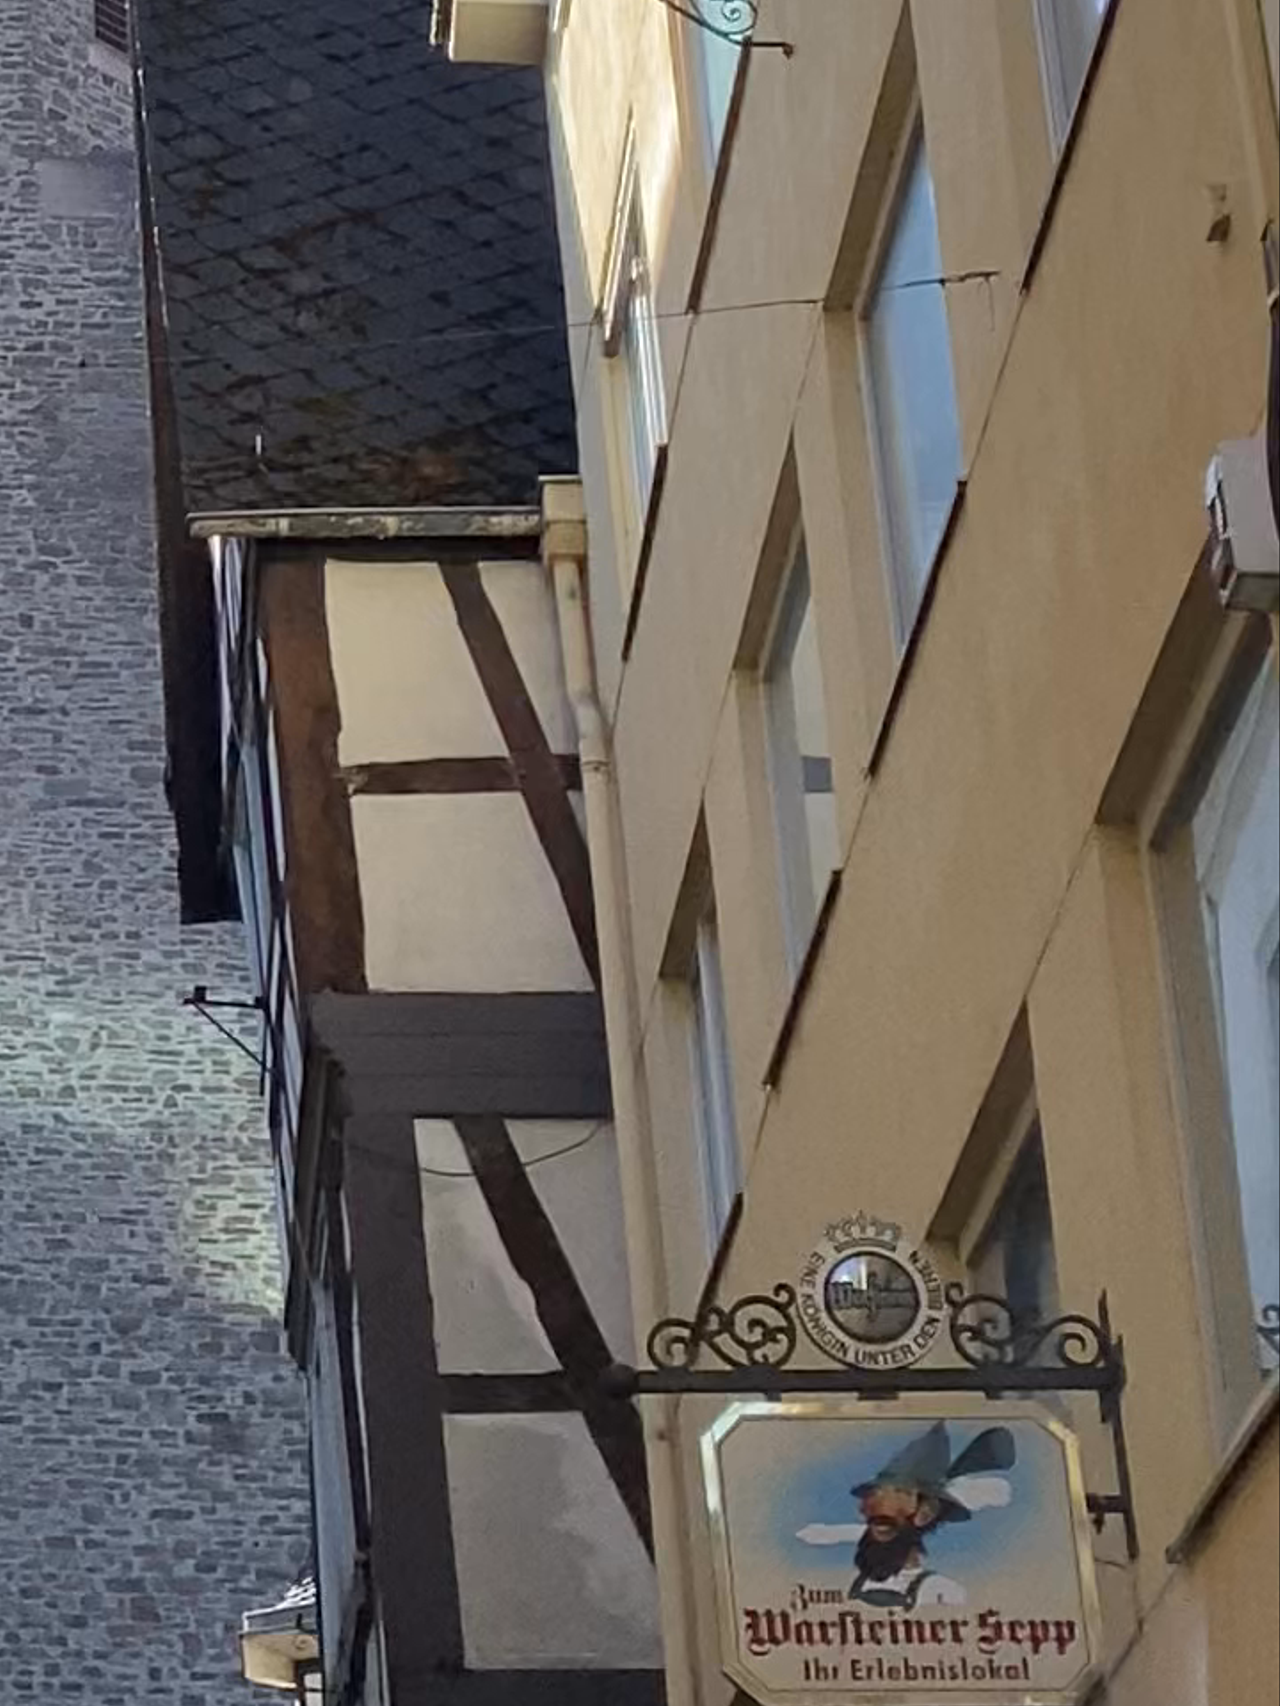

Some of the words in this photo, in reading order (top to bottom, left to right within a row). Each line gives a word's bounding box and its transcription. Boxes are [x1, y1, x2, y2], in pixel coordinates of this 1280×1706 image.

[854, 1343, 916, 1366] UNTER
[917, 1316, 942, 1350] DEN
[790, 1583, 844, 1613] Zum
[976, 1607, 1076, 1657] Sepp
[802, 1658, 841, 1684] Ihr
[850, 1655, 1031, 1683] Erlebnislokal
